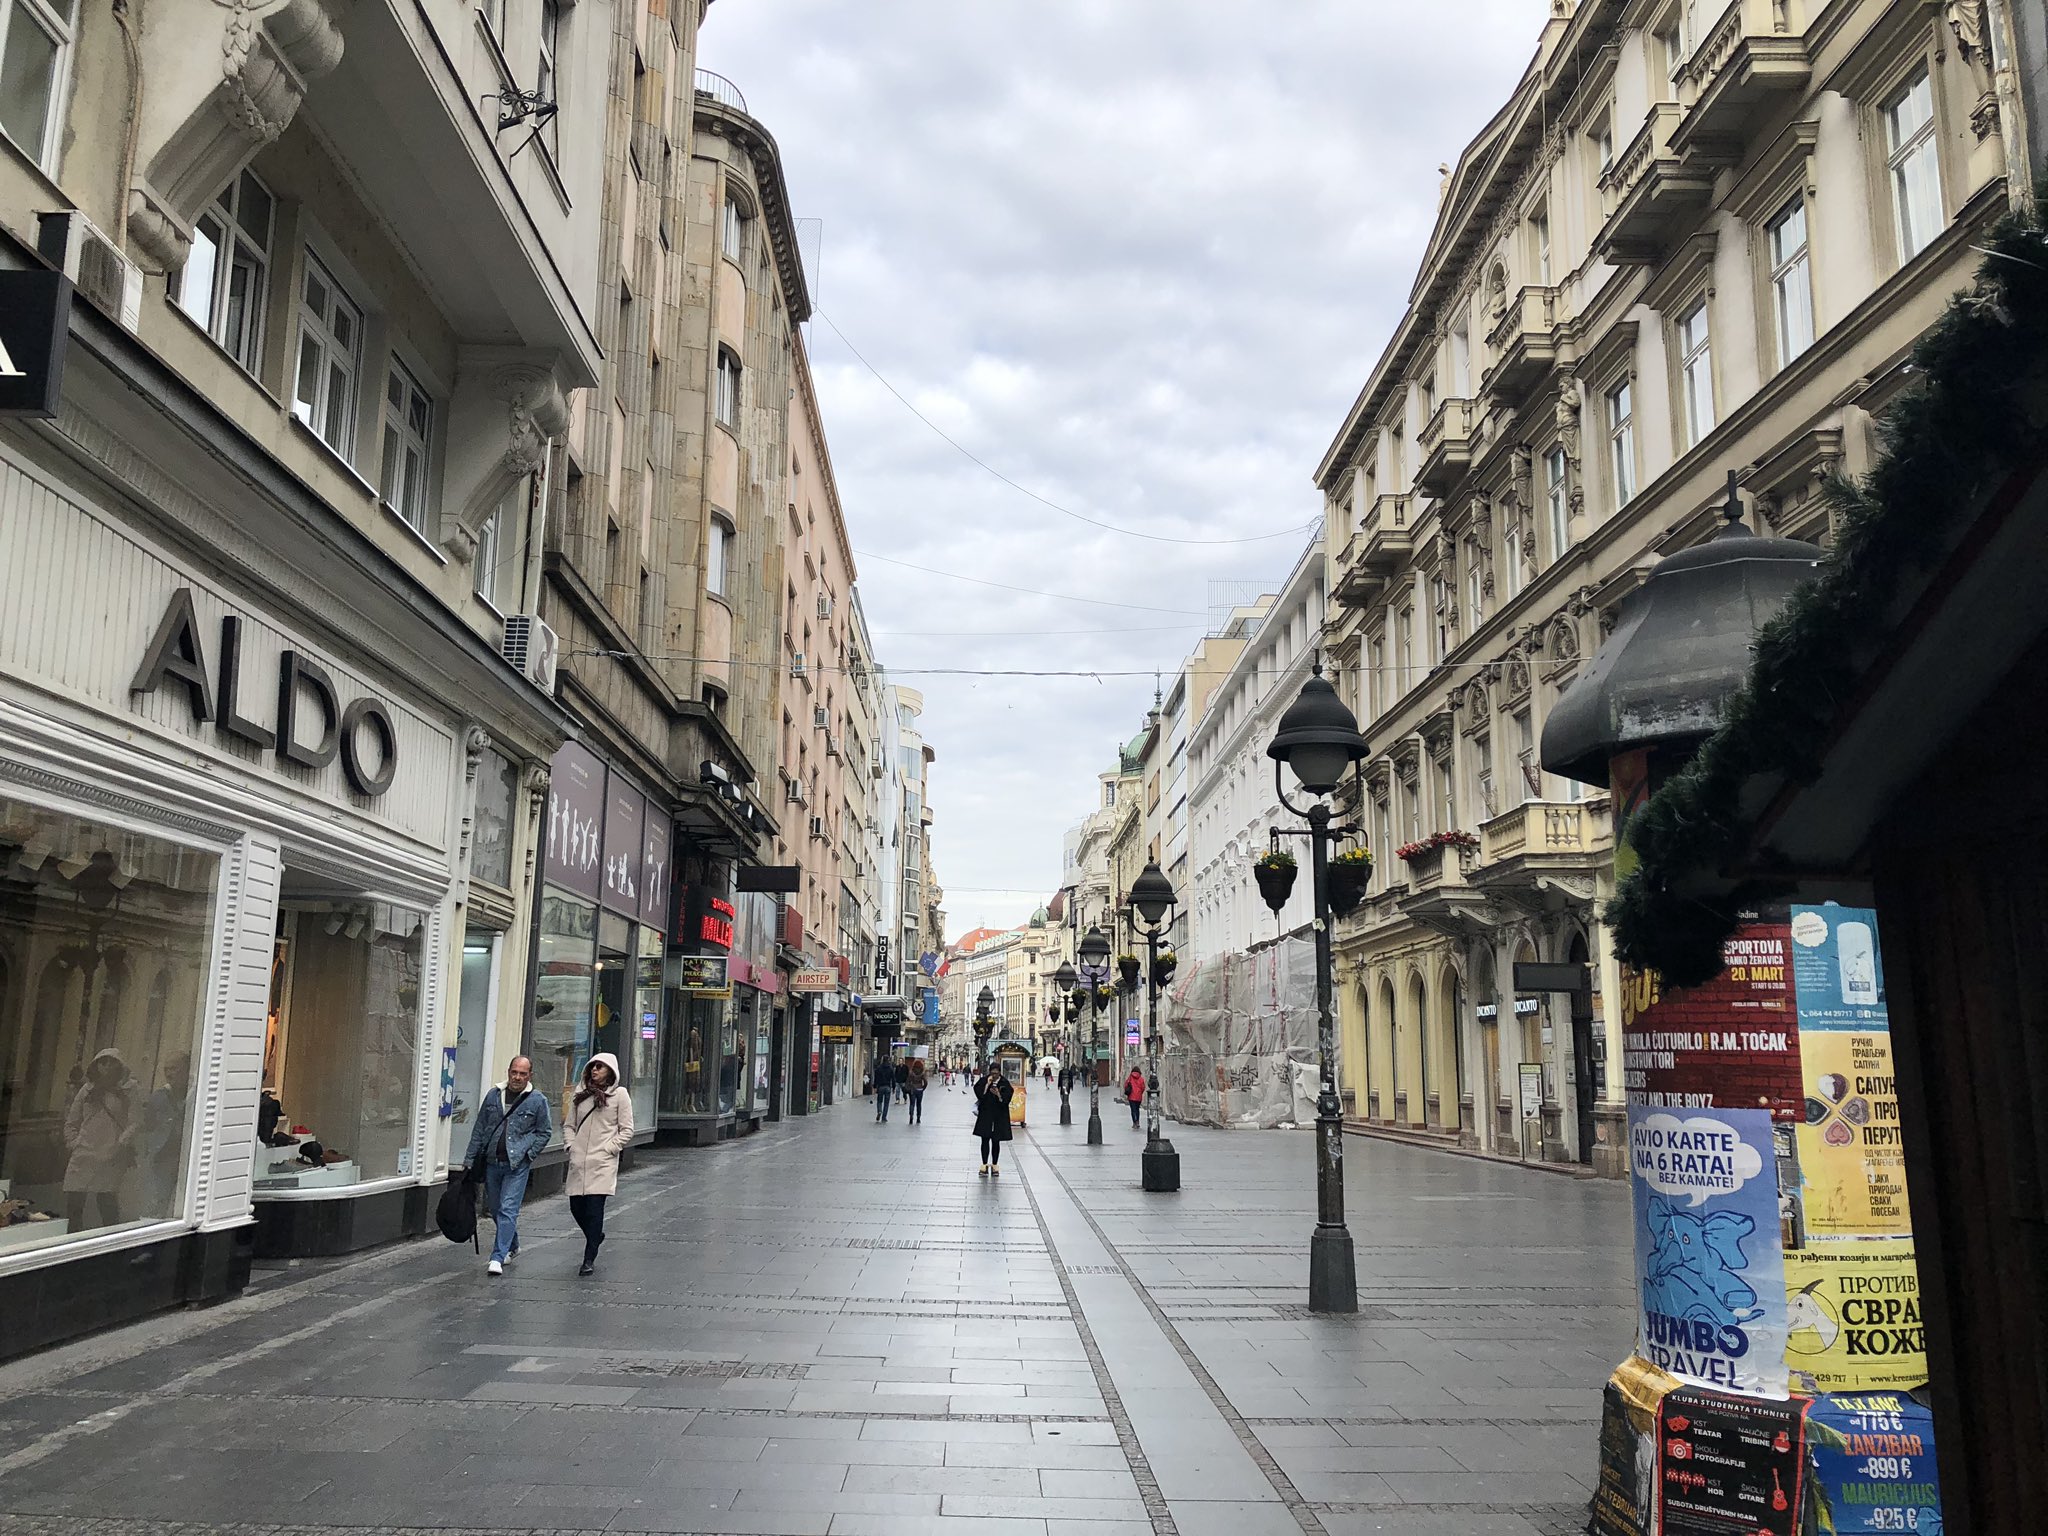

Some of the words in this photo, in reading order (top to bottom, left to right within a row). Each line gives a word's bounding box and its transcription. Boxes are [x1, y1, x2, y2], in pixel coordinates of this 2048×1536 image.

[130, 588, 398, 797] ALDO
[879, 937, 887, 978] HOTEL
[796, 974, 830, 984] AIRSTEP
[1731, 967, 1750, 981] 20.
[1751, 967, 1785, 981] MART
[1514, 999, 1538, 1012] INCANTO
[1652, 1030, 1702, 1050] ČUTURILO
[1851, 1038, 1873, 1047] РУЧНО
[1665, 1093, 1683, 1108] THE
[1635, 1129, 1664, 1148] AVIO
[1667, 1130, 1734, 1151] KARTE
[1637, 1151, 1655, 1169] NA
[1657, 1153, 1668, 1171] 6
[1672, 1153, 1735, 1176] RATA!
[1659, 1171, 1677, 1184] BEZ
[1678, 1173, 1734, 1188] KAMATE!
[1869, 1196, 1891, 1206] СВАКИ
[1871, 1206, 1900, 1217] ПОСЕБАН
[1801, 1252, 1837, 1262] рађени
[1839, 1276, 1916, 1294] ПРОТИВ
[1648, 1311, 1749, 1358] JUMBO
[1650, 1344, 1745, 1391] TRAVEL
[1672, 1395, 1698, 1404] KLUBA
[1700, 1400, 1750, 1412] STUDENATA
[1753, 1408, 1791, 1419] TEHNIKE
[1693, 1419, 1707, 1428] KST
[1857, 1411, 1890, 1431] 775
[1892, 1412, 1904, 1431] €
[1693, 1428, 1722, 1439] TEATAR
[1740, 1435, 1771, 1447] TRIBINE
[1694, 1443, 1719, 1455] ŠKOLU
[1844, 1433, 1924, 1456] ZANZIBAR
[1694, 1453, 1746, 1468] FOTOGRAFIJE
[1867, 1457, 1899, 1479] 899
[1901, 1457, 1913, 1479] €
[1707, 1478, 1721, 1487] KST
[1707, 1487, 1724, 1496] HOR
[1738, 1493, 1766, 1504] GITARE
[1667, 1498, 1694, 1510] SUBOTA
[1906, 1507, 1918, 1531] €
